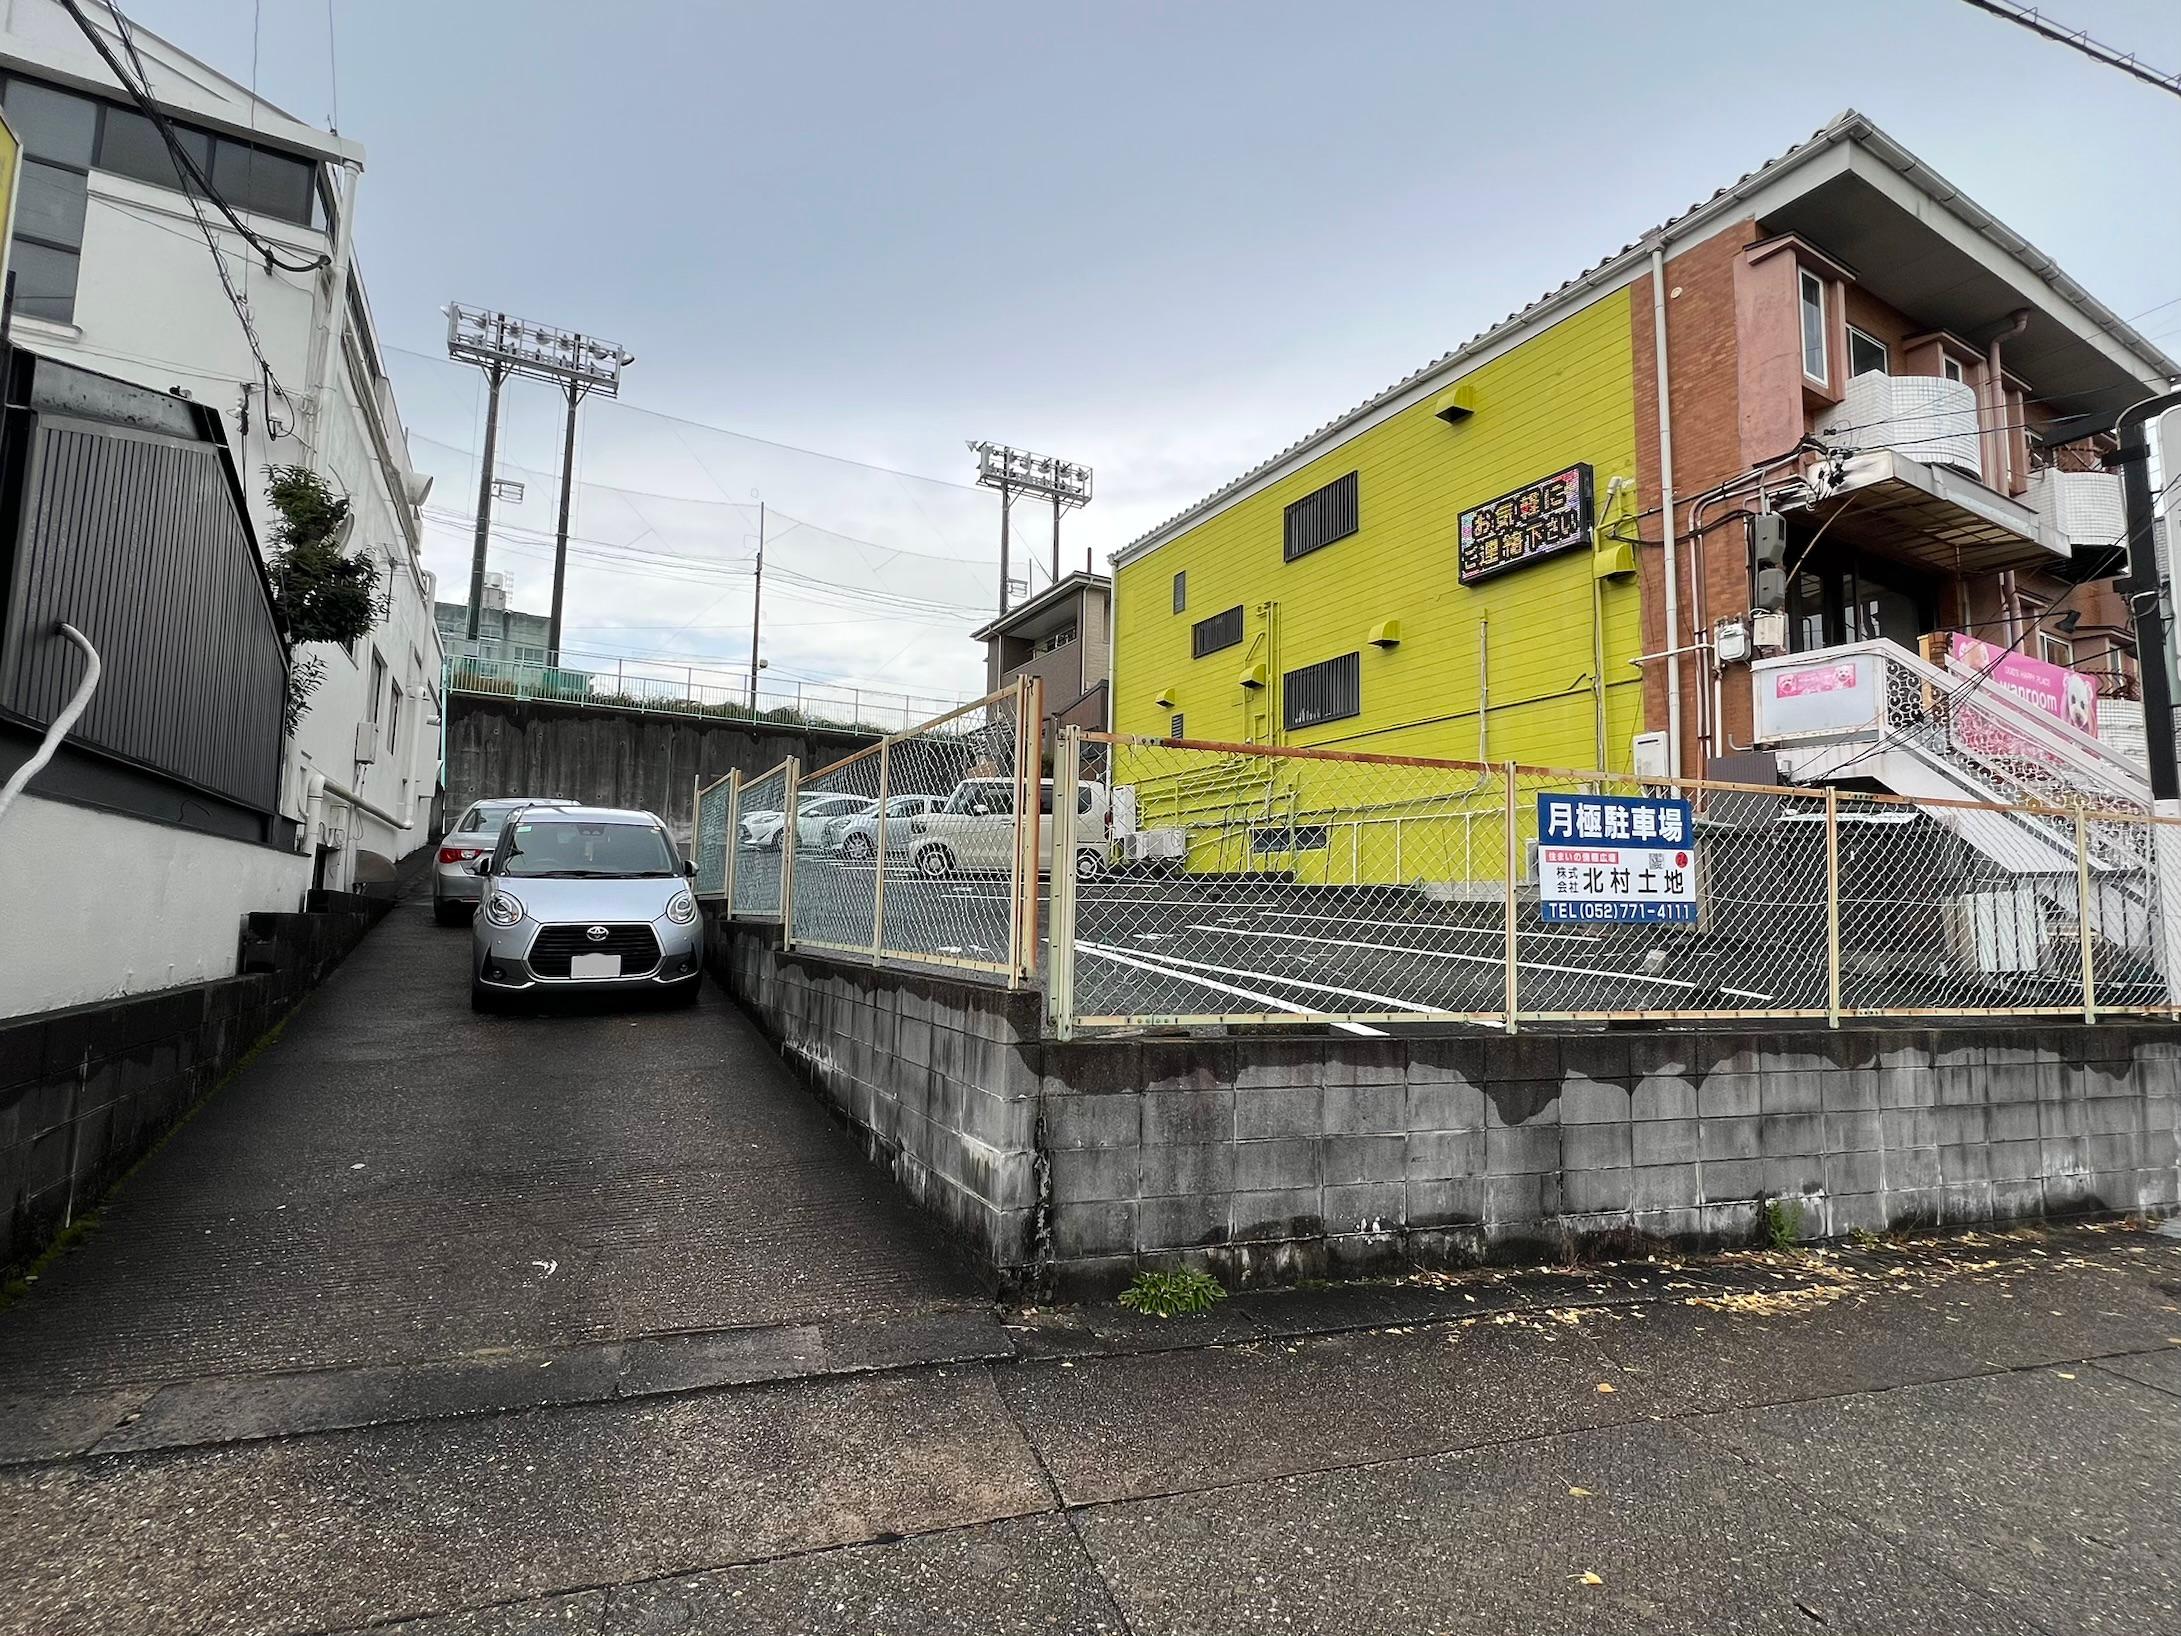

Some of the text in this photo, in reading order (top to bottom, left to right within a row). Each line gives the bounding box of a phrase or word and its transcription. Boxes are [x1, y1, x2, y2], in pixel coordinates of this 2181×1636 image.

[1474, 484, 1567, 536] お気軽に
[1464, 514, 1578, 570] ご連絡下さい
[1547, 801, 1684, 842] 月極駐車場
[1583, 867, 1684, 894] 北村土地
